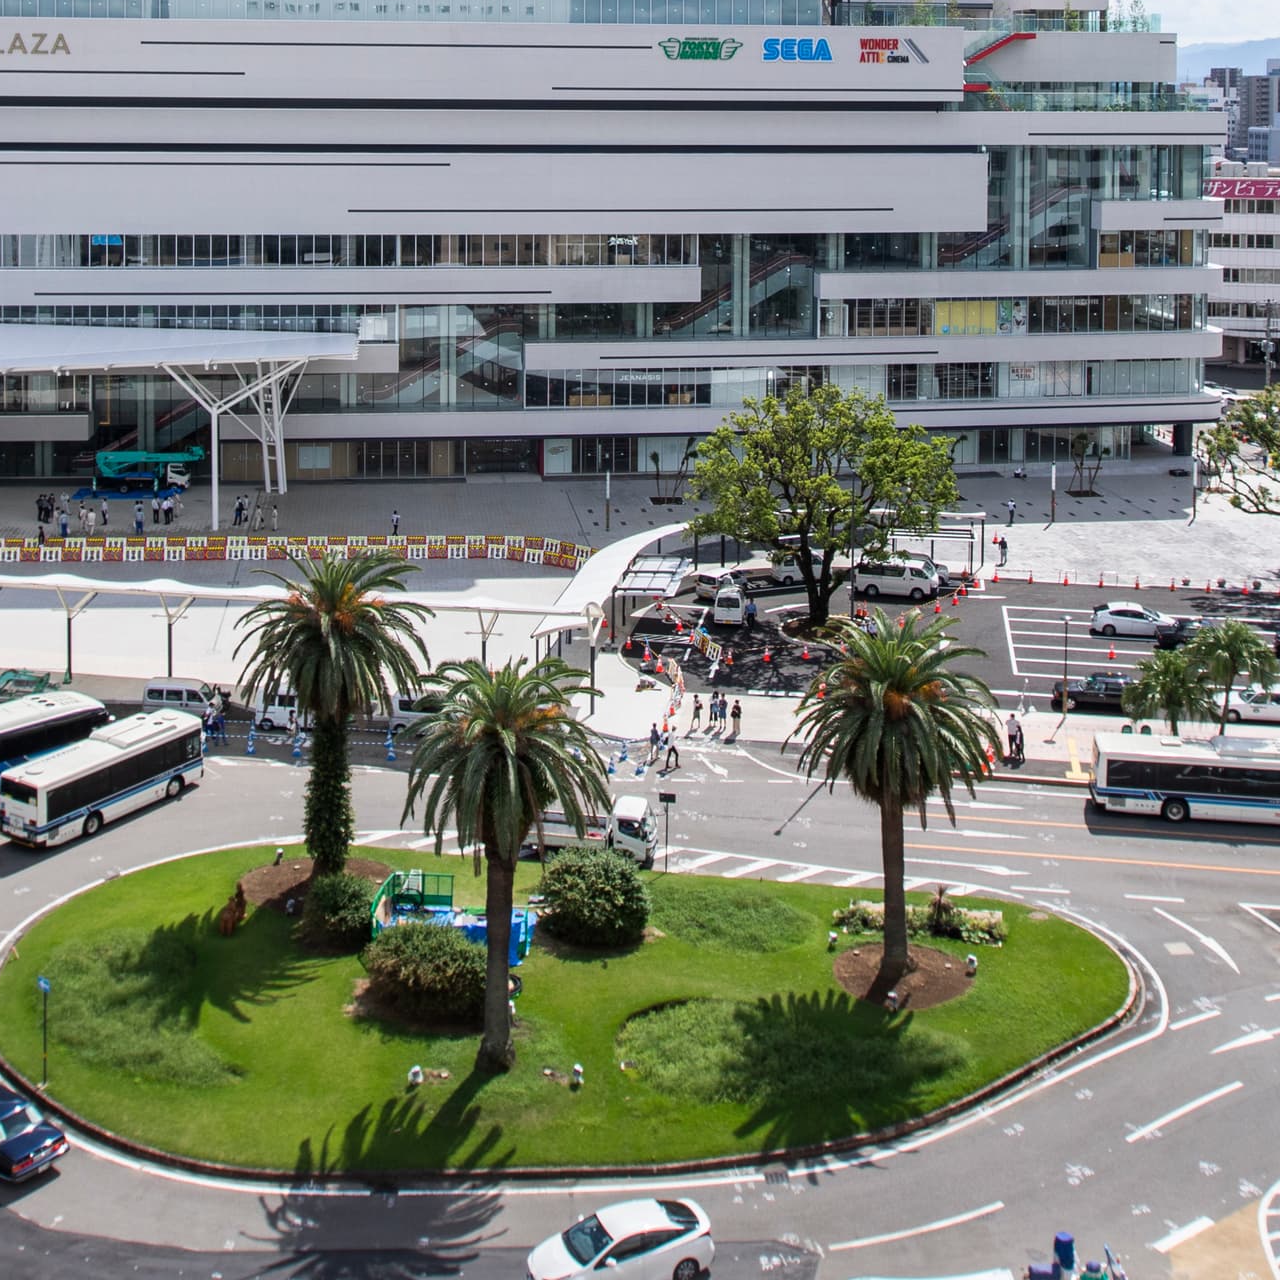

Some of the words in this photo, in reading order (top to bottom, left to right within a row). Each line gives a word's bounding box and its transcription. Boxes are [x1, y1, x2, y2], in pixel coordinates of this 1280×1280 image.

[681, 41, 721, 51] TOKYU
[762, 38, 833, 61] SEGA
[859, 38, 899, 50] WONDER
[887, 54, 910, 64] CINEMA
